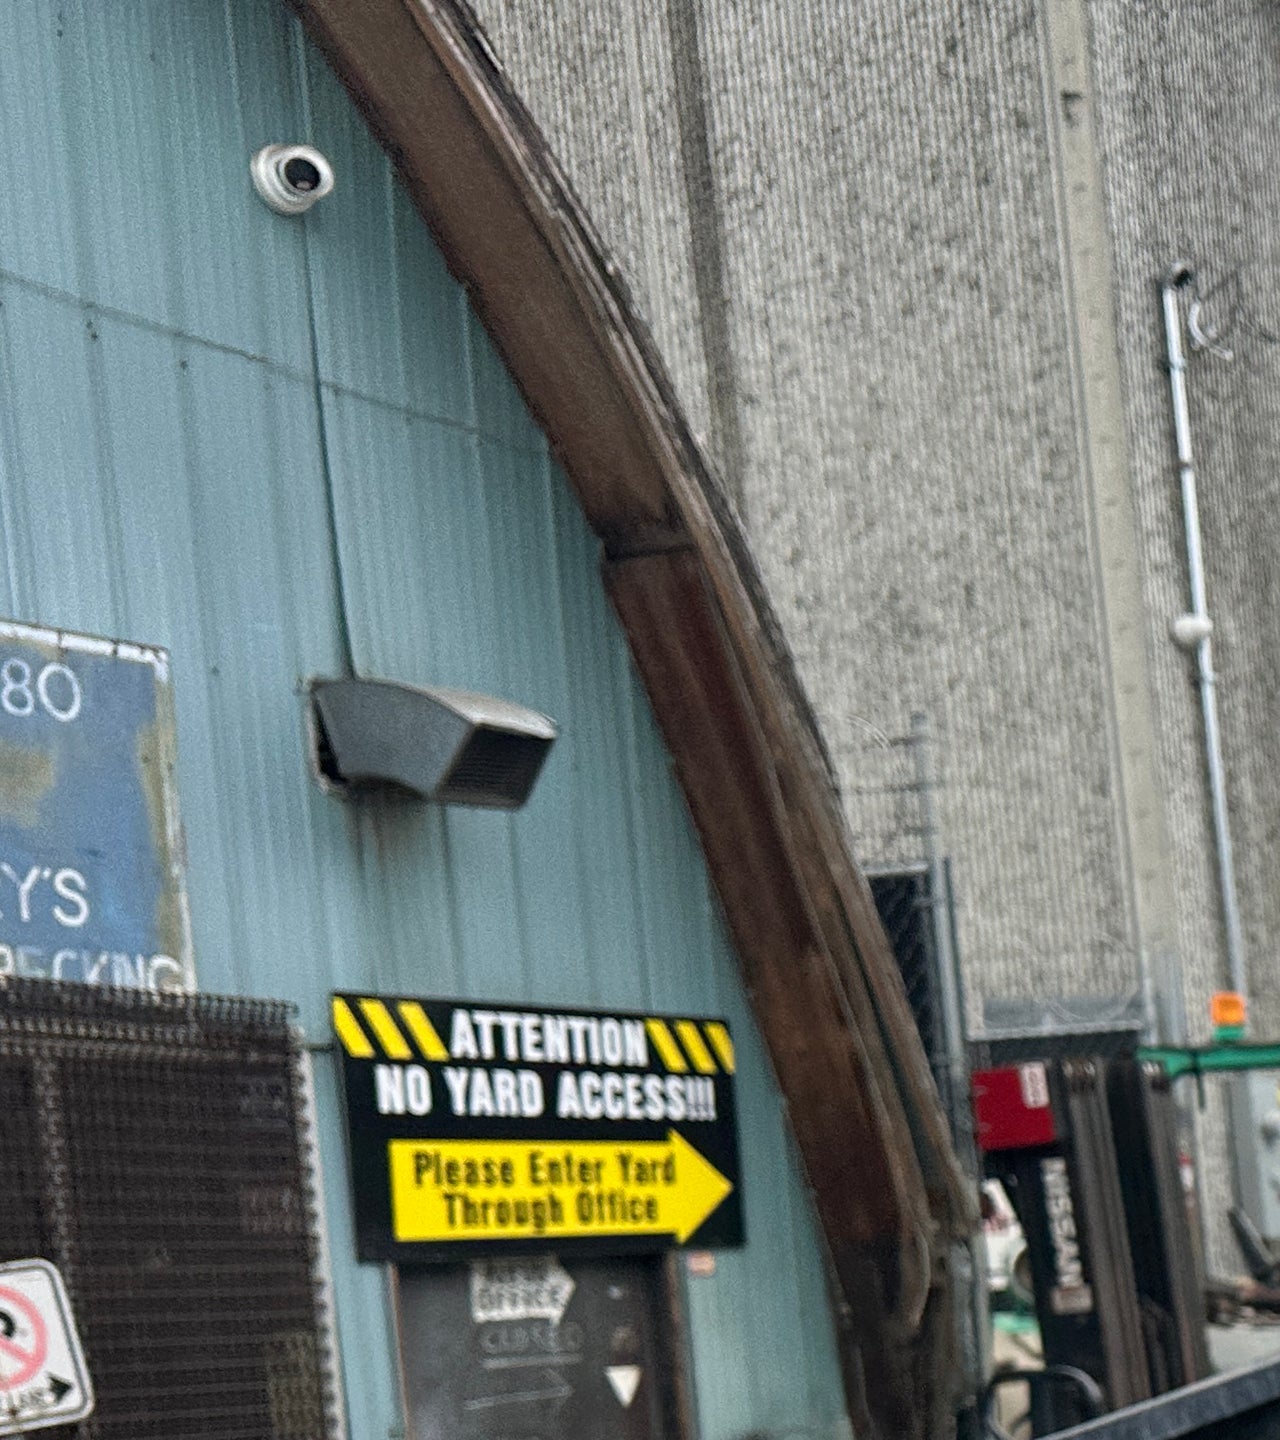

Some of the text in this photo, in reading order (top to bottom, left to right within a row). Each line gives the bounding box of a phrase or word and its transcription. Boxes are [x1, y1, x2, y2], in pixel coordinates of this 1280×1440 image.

[450, 1008, 650, 1068] ATTENTION
[374, 1064, 717, 1122] NO YARD ACCESS!!!
[413, 1148, 676, 1187] Please Enter Yard
[443, 1190, 659, 1235] Through Office
